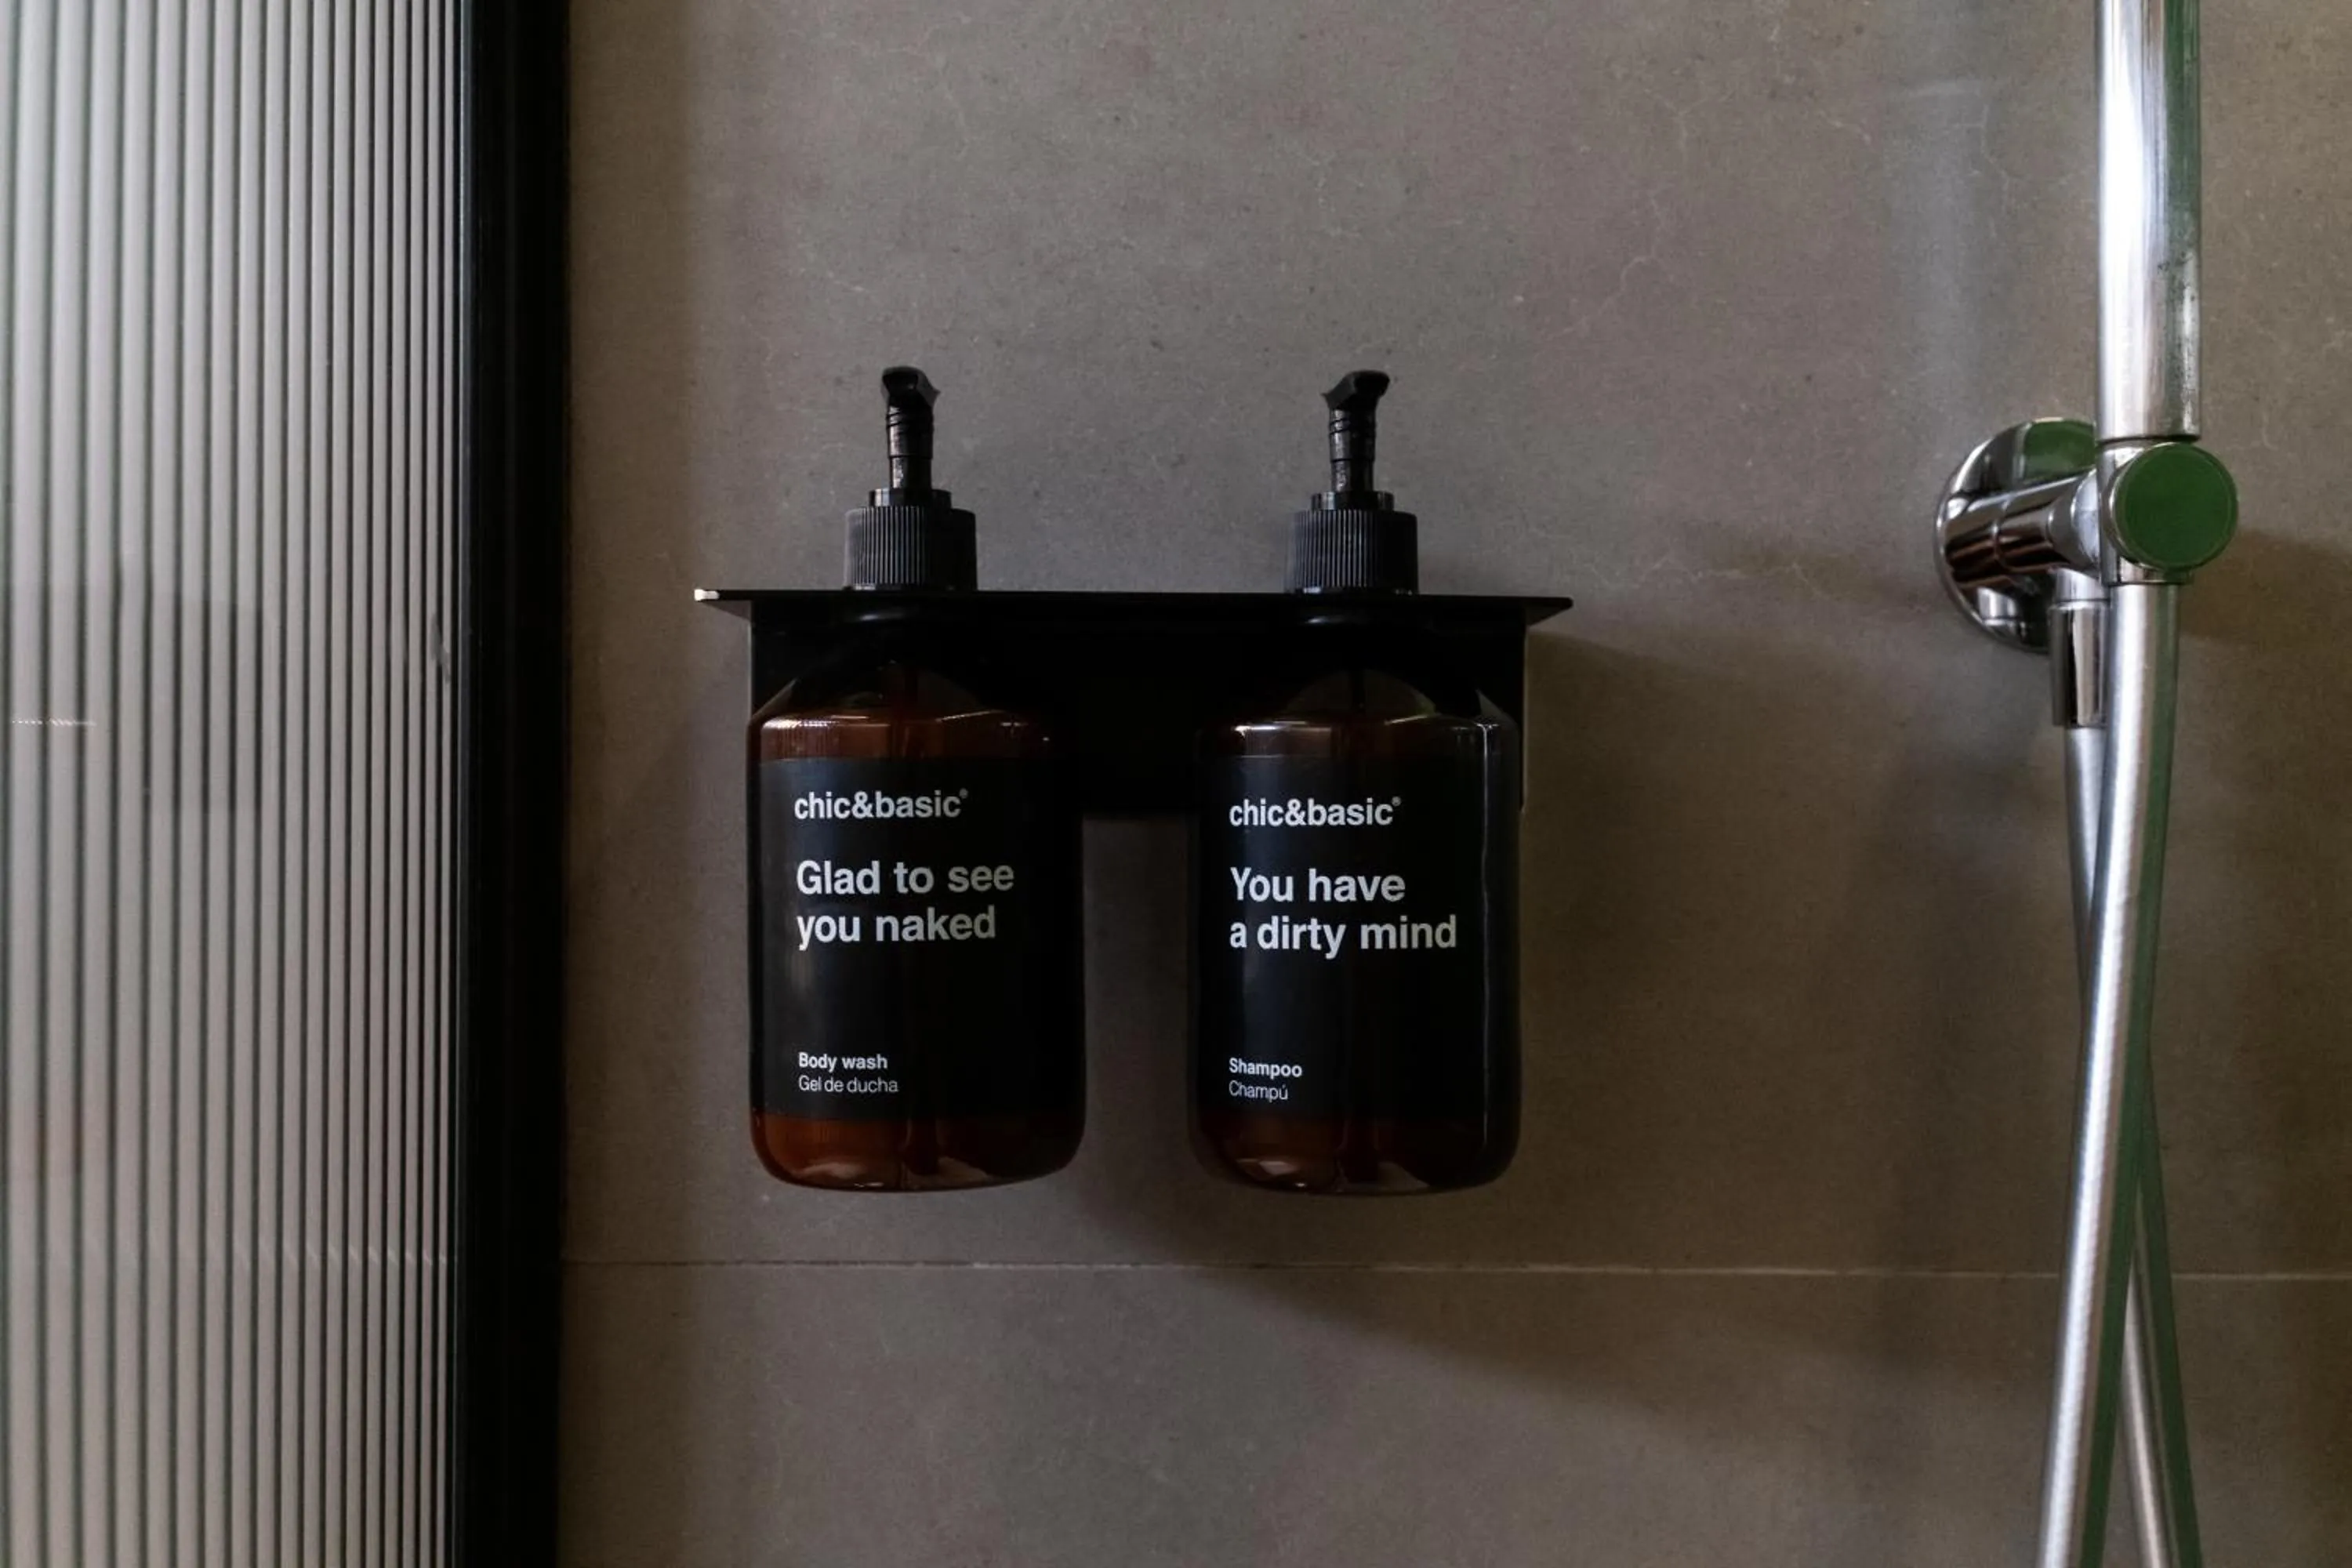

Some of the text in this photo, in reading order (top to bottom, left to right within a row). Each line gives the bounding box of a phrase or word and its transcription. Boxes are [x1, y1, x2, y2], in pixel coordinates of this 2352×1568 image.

[797, 859, 1014, 895] Glad to see
[1230, 866, 1406, 902] You have
[796, 905, 996, 951] you naked
[1229, 914, 1457, 960] a dirty mind
[798, 1051, 888, 1073] Body wash
[1229, 1057, 1303, 1080] Shampoo
[798, 1075, 899, 1094] Gel de ducha
[1229, 1079, 1288, 1103] Champú
